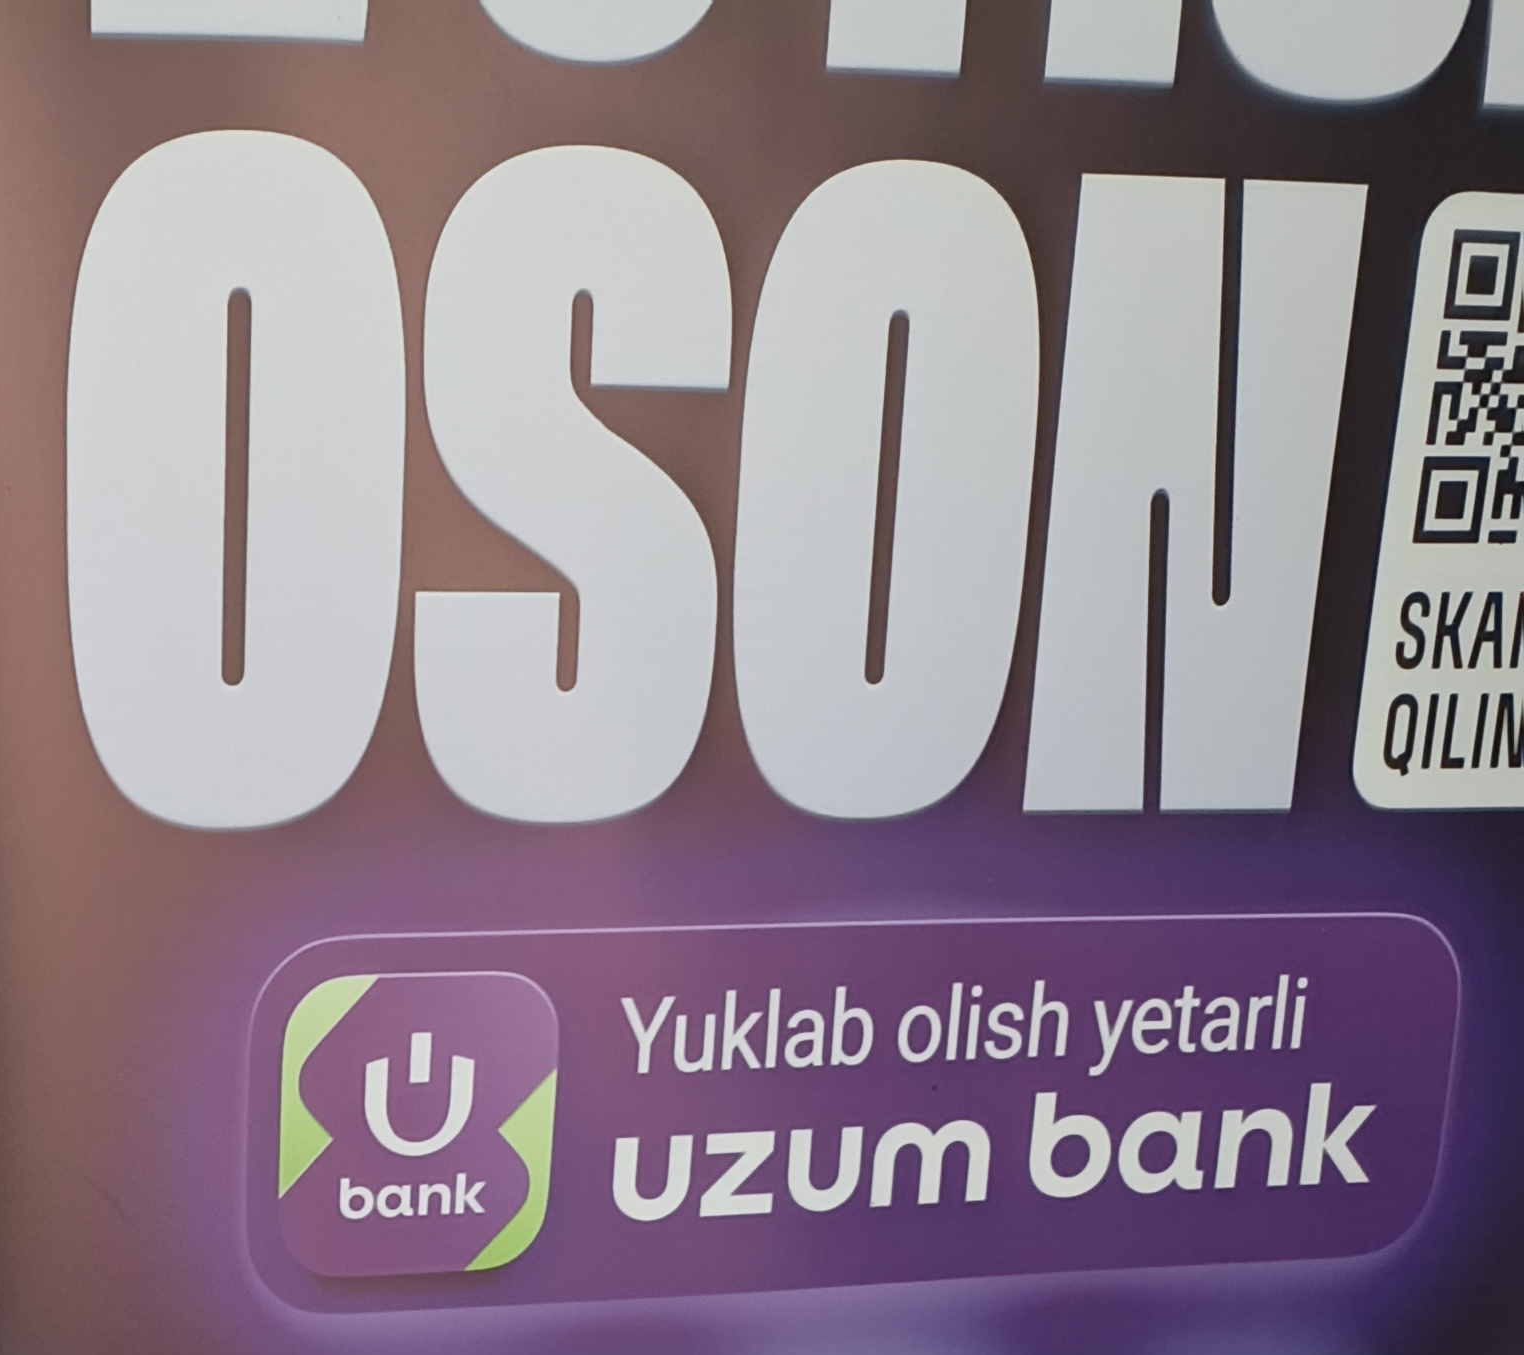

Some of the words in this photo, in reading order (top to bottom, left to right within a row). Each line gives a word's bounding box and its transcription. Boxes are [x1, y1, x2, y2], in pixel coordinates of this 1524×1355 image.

[67, 129, 1368, 831] OSON
[620, 987, 874, 1074] Yuklab
[897, 980, 1070, 1063] olish
[1088, 974, 1309, 1076] yetarli
[338, 1173, 486, 1220] bank
[612, 1119, 991, 1222] uzum
[1028, 1082, 1377, 1199] bank
